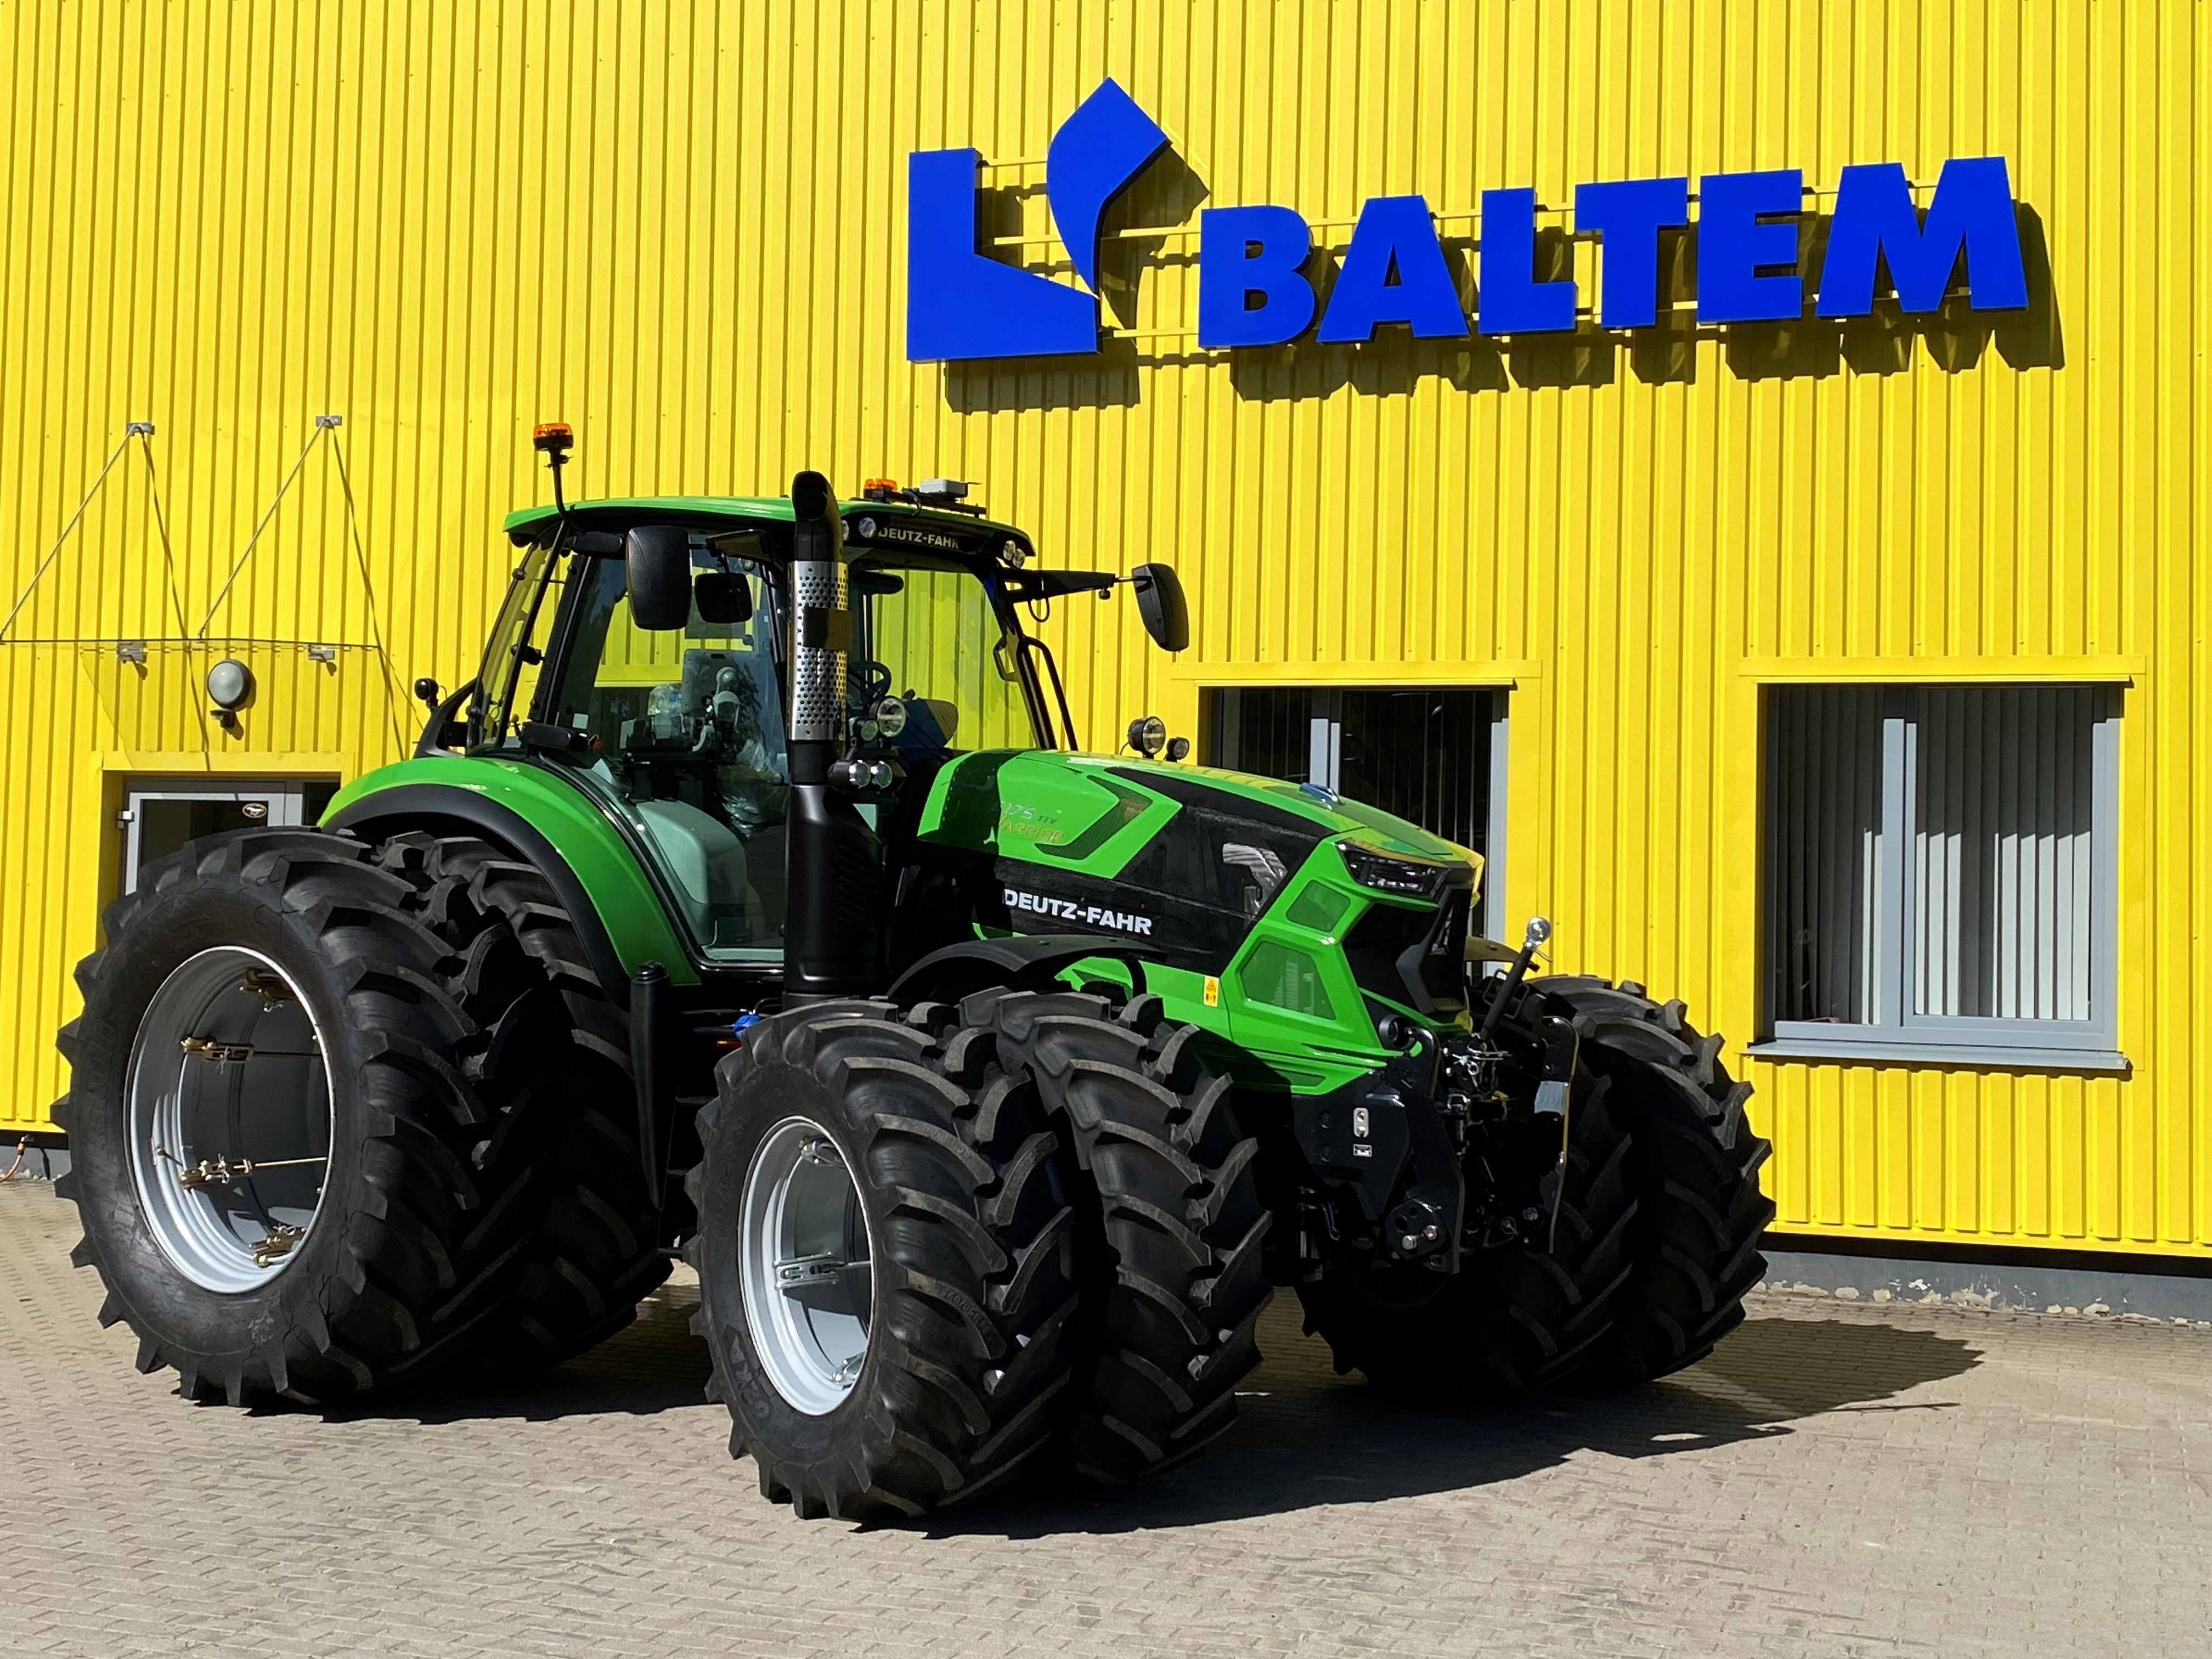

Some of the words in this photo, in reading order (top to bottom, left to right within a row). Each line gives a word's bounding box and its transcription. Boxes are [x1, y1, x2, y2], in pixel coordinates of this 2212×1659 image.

[1199, 156, 2030, 350] BALTEM
[878, 527, 960, 549] DEUTZ-FAHR
[1002, 888, 1152, 935] DEUTZ-FAHR
